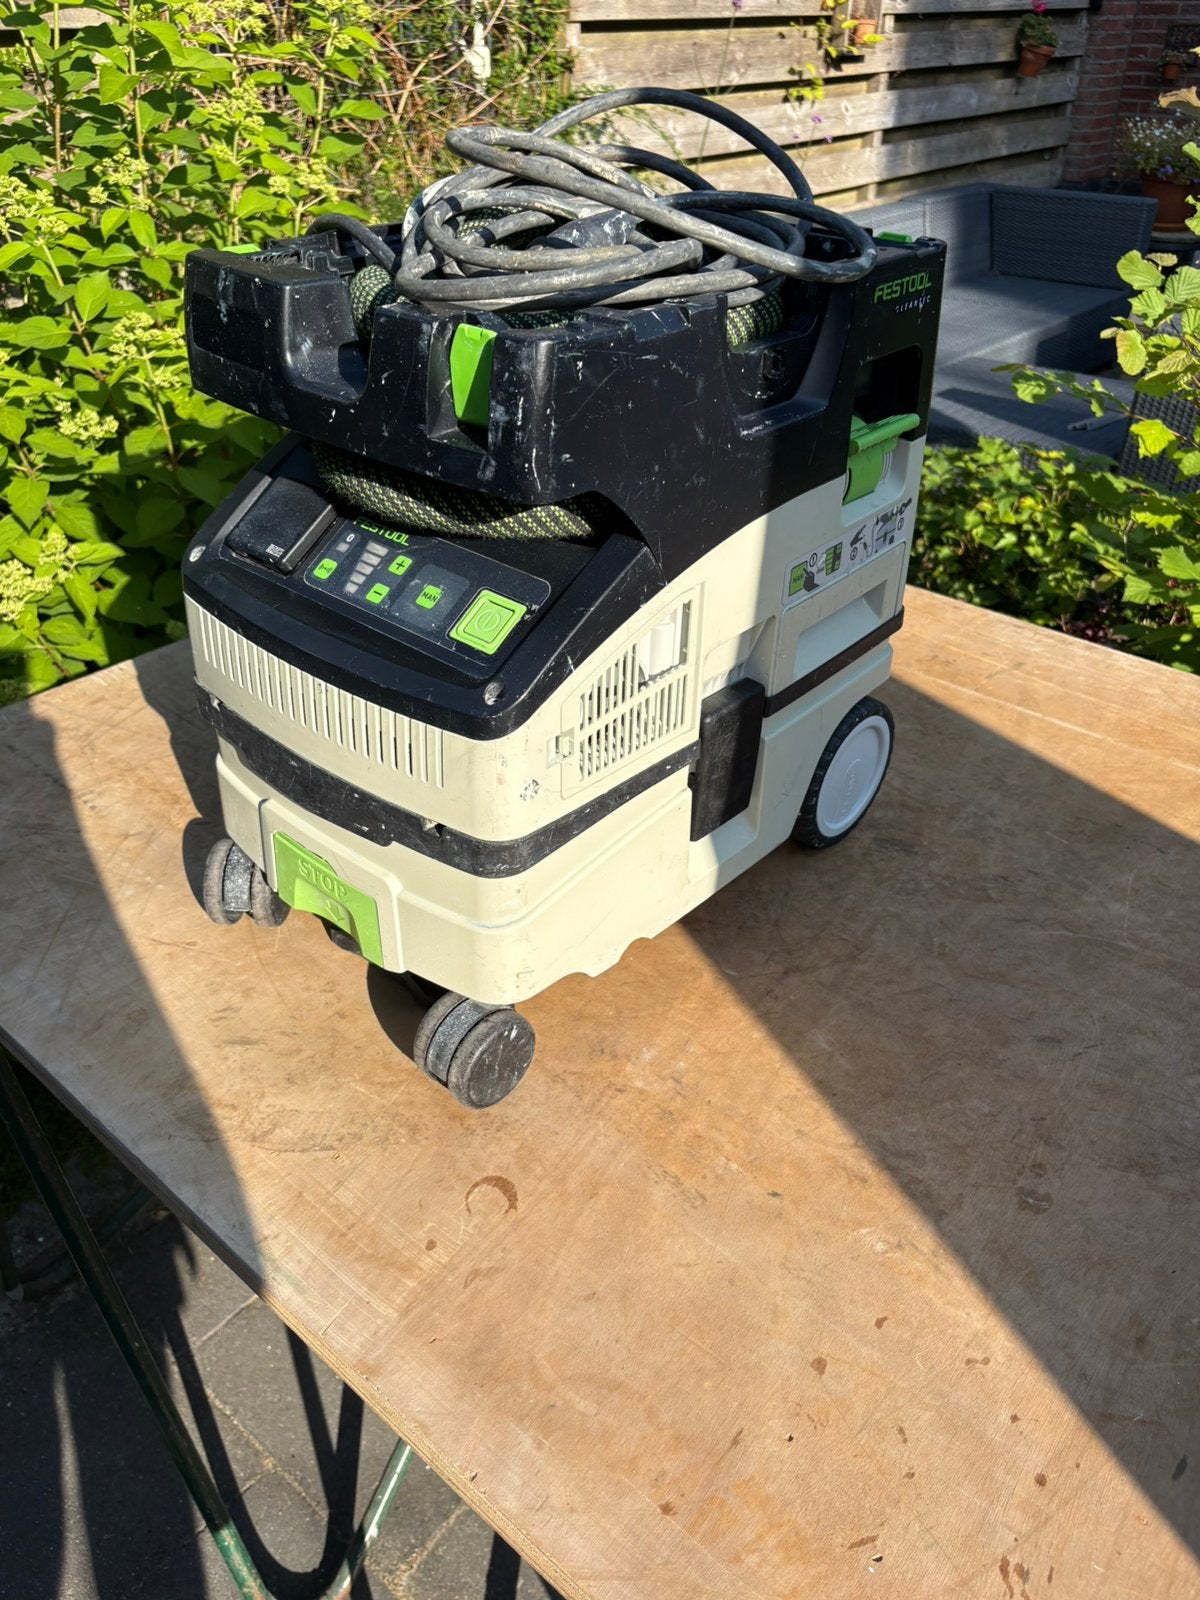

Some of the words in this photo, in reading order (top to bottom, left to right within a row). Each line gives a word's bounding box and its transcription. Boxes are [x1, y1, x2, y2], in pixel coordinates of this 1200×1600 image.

[874, 272, 931, 304] FESTOOL
[421, 591, 439, 603] MAN
[298, 859, 347, 898] STOP
